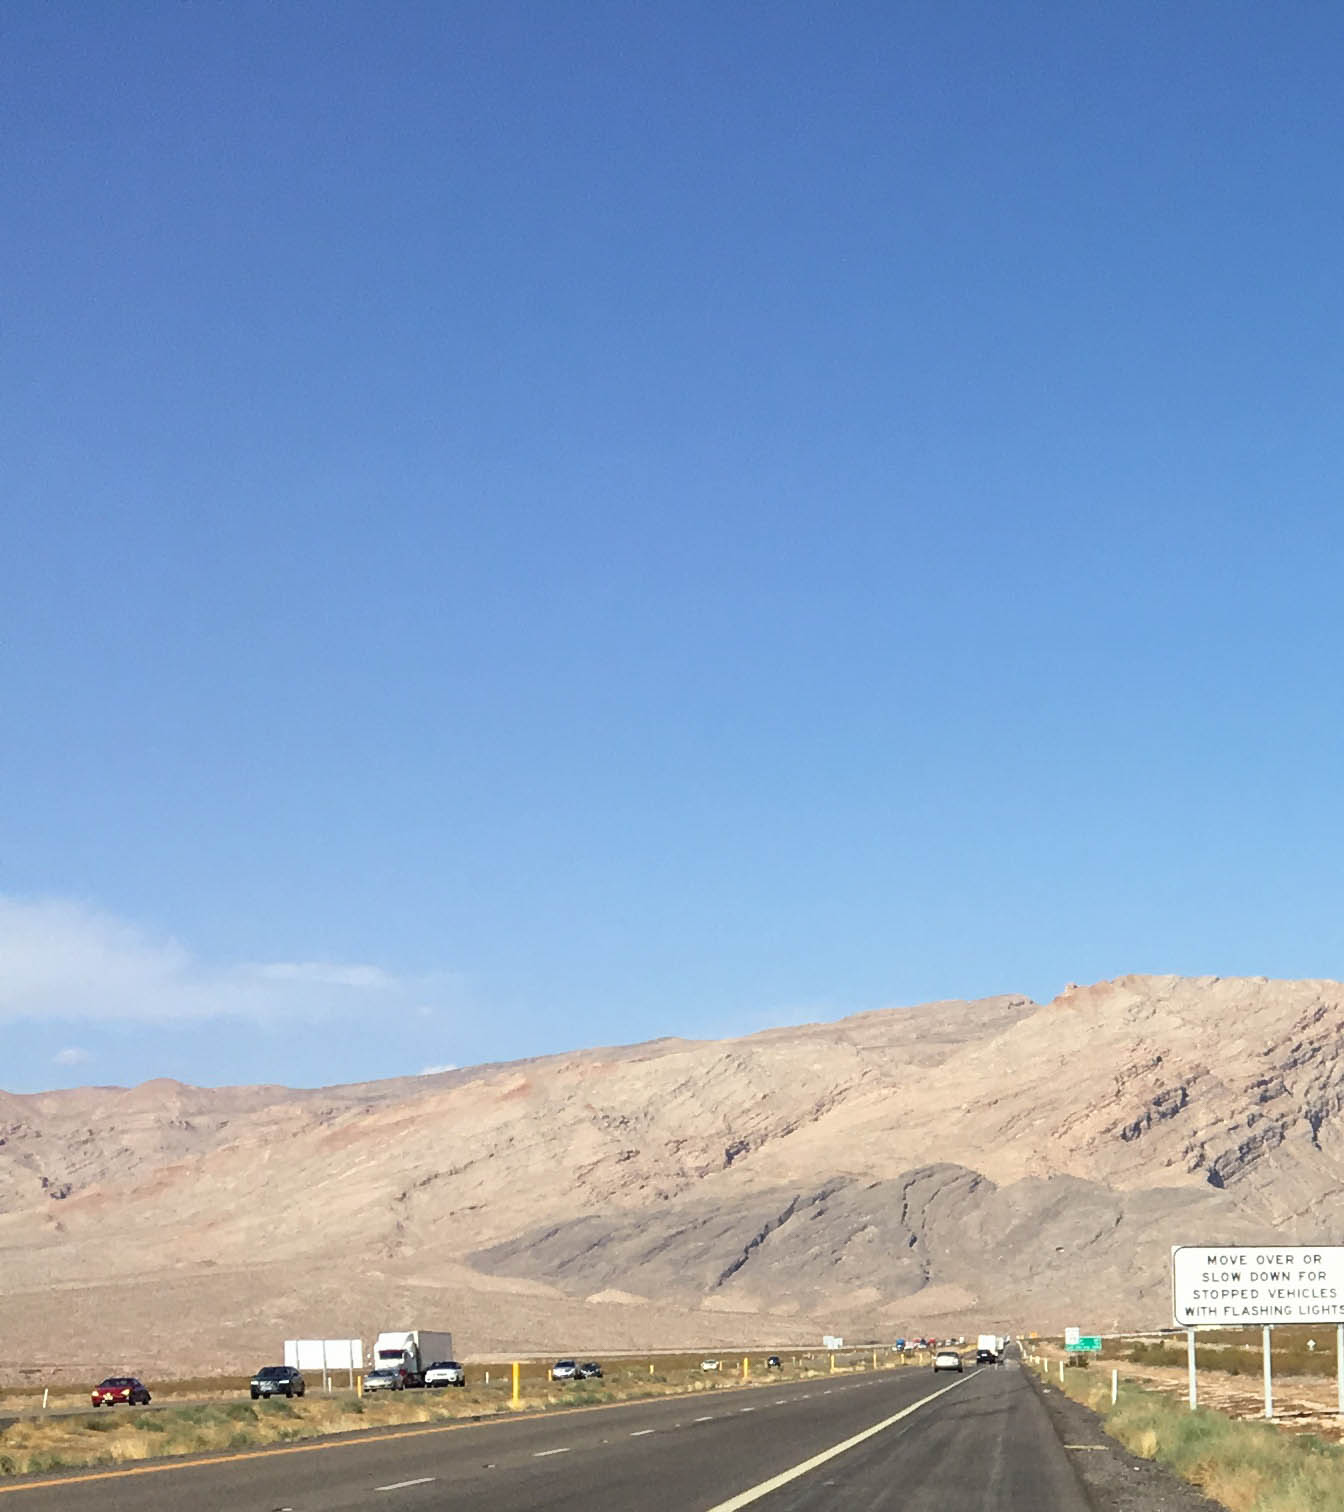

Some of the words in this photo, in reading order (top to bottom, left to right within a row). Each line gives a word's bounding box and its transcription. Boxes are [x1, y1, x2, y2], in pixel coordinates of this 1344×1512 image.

[1207, 1255, 1247, 1265] MOVE
[1256, 1254, 1294, 1264] OVER
[1303, 1254, 1322, 1264] OR
[1202, 1272, 1241, 1282] SLOW
[1250, 1271, 1290, 1281] DOWN
[1299, 1271, 1327, 1281] FOR
[1193, 1289, 1259, 1299] STOPPED
[1268, 1288, 1337, 1298] VEHICLES
[1185, 1306, 1217, 1317] WITH
[1224, 1305, 1293, 1316] FLASHING
